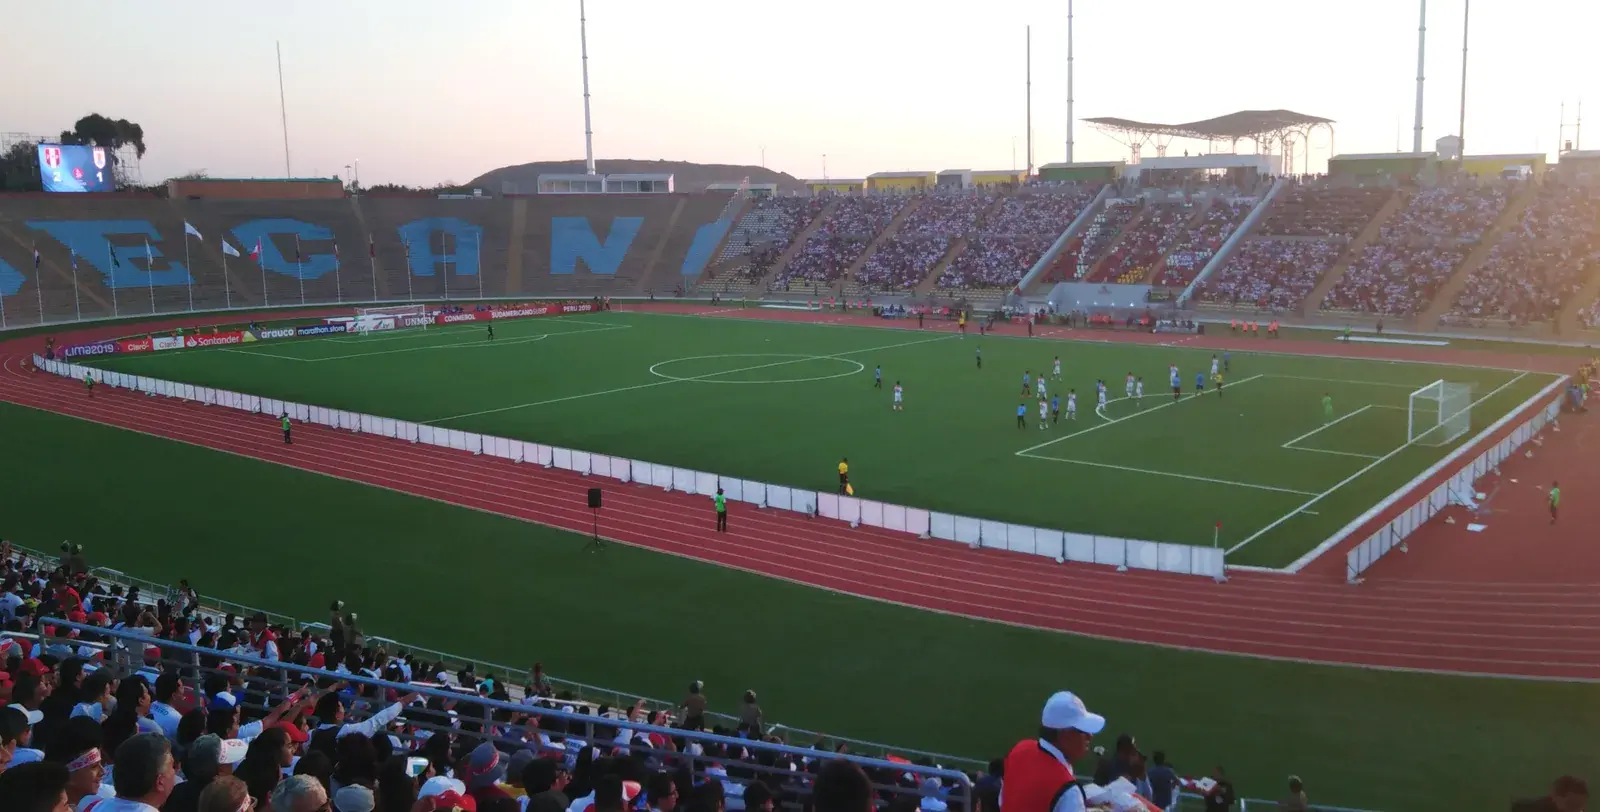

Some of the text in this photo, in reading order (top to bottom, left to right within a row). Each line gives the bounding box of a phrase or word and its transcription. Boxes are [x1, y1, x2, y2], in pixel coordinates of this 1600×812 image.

[53, 171, 62, 182] 2
[96, 171, 103, 183] 1
[405, 317, 436, 327] UNMSM
[444, 313, 476, 323] CONMEBOL
[261, 328, 294, 339] arauco
[159, 341, 177, 349] Claro
[198, 334, 240, 346] Santander
[127, 342, 148, 351] Claro
